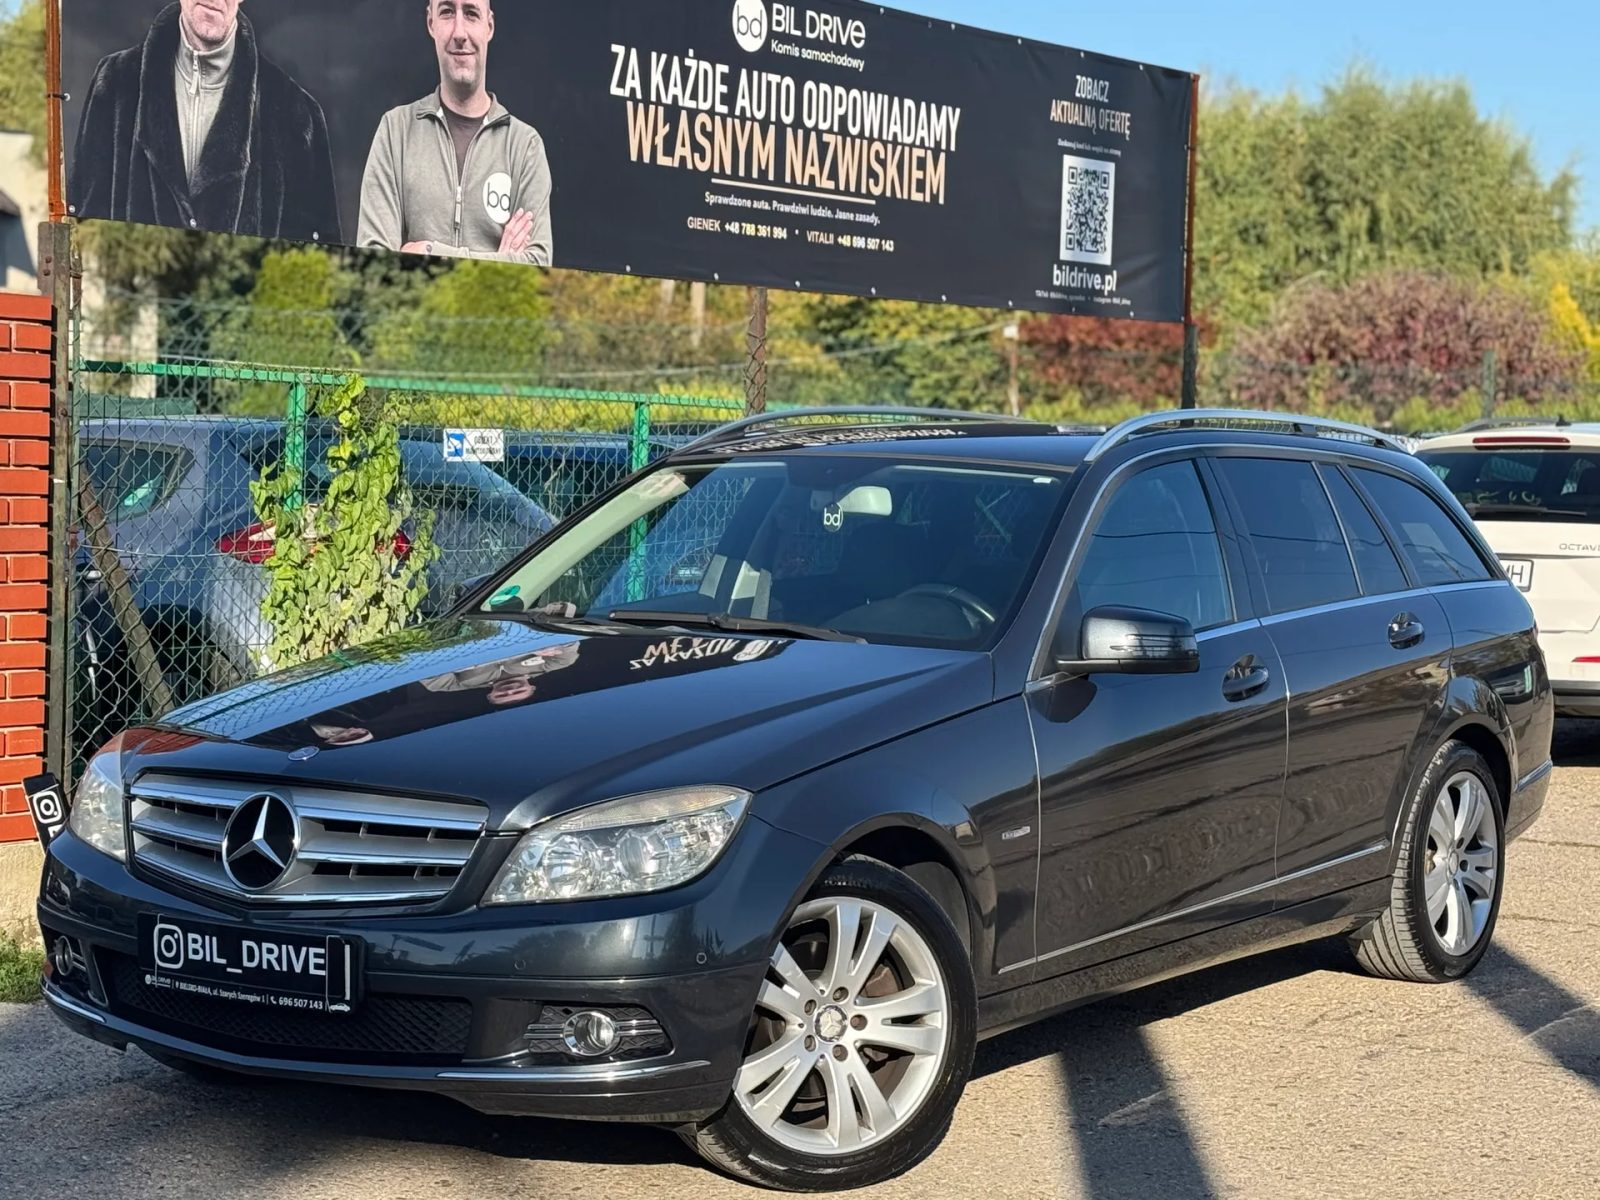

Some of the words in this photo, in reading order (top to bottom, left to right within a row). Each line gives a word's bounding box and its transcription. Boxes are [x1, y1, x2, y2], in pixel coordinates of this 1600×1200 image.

[737, 4, 762, 40] bd
[771, 3, 802, 36] BIL
[771, 39, 800, 57] Komis
[801, 48, 865, 72] samochodowy
[610, 44, 642, 99] ZA
[650, 49, 729, 114] KAŻDE
[735, 68, 795, 124] AUTO
[802, 80, 961, 151] ODPOWIADAMY
[1075, 75, 1109, 103] ZOBACZ
[1050, 98, 1097, 135] AKTUALNĄ
[1099, 108, 1131, 141] OFERTĘ
[626, 101, 775, 181] WŁASNYM
[785, 129, 946, 204] NAZWISKIEM
[687, 216, 721, 232] GIENEK
[724, 221, 740, 234] +48
[705, 191, 752, 208] Sprawdzone
[753, 199, 771, 211] auta.
[772, 200, 809, 215] Prawdziwi
[810, 204, 833, 219] ludzie.
[835, 208, 854, 221] Jasne
[855, 212, 880, 226] zasady.
[1053, 263, 1117, 296] bildrive.pl
[187, 933, 326, 976] BIL_DRIVE
[279, 996, 293, 1006] 696
[294, 998, 308, 1008] 507
[309, 1000, 323, 1010] 143
